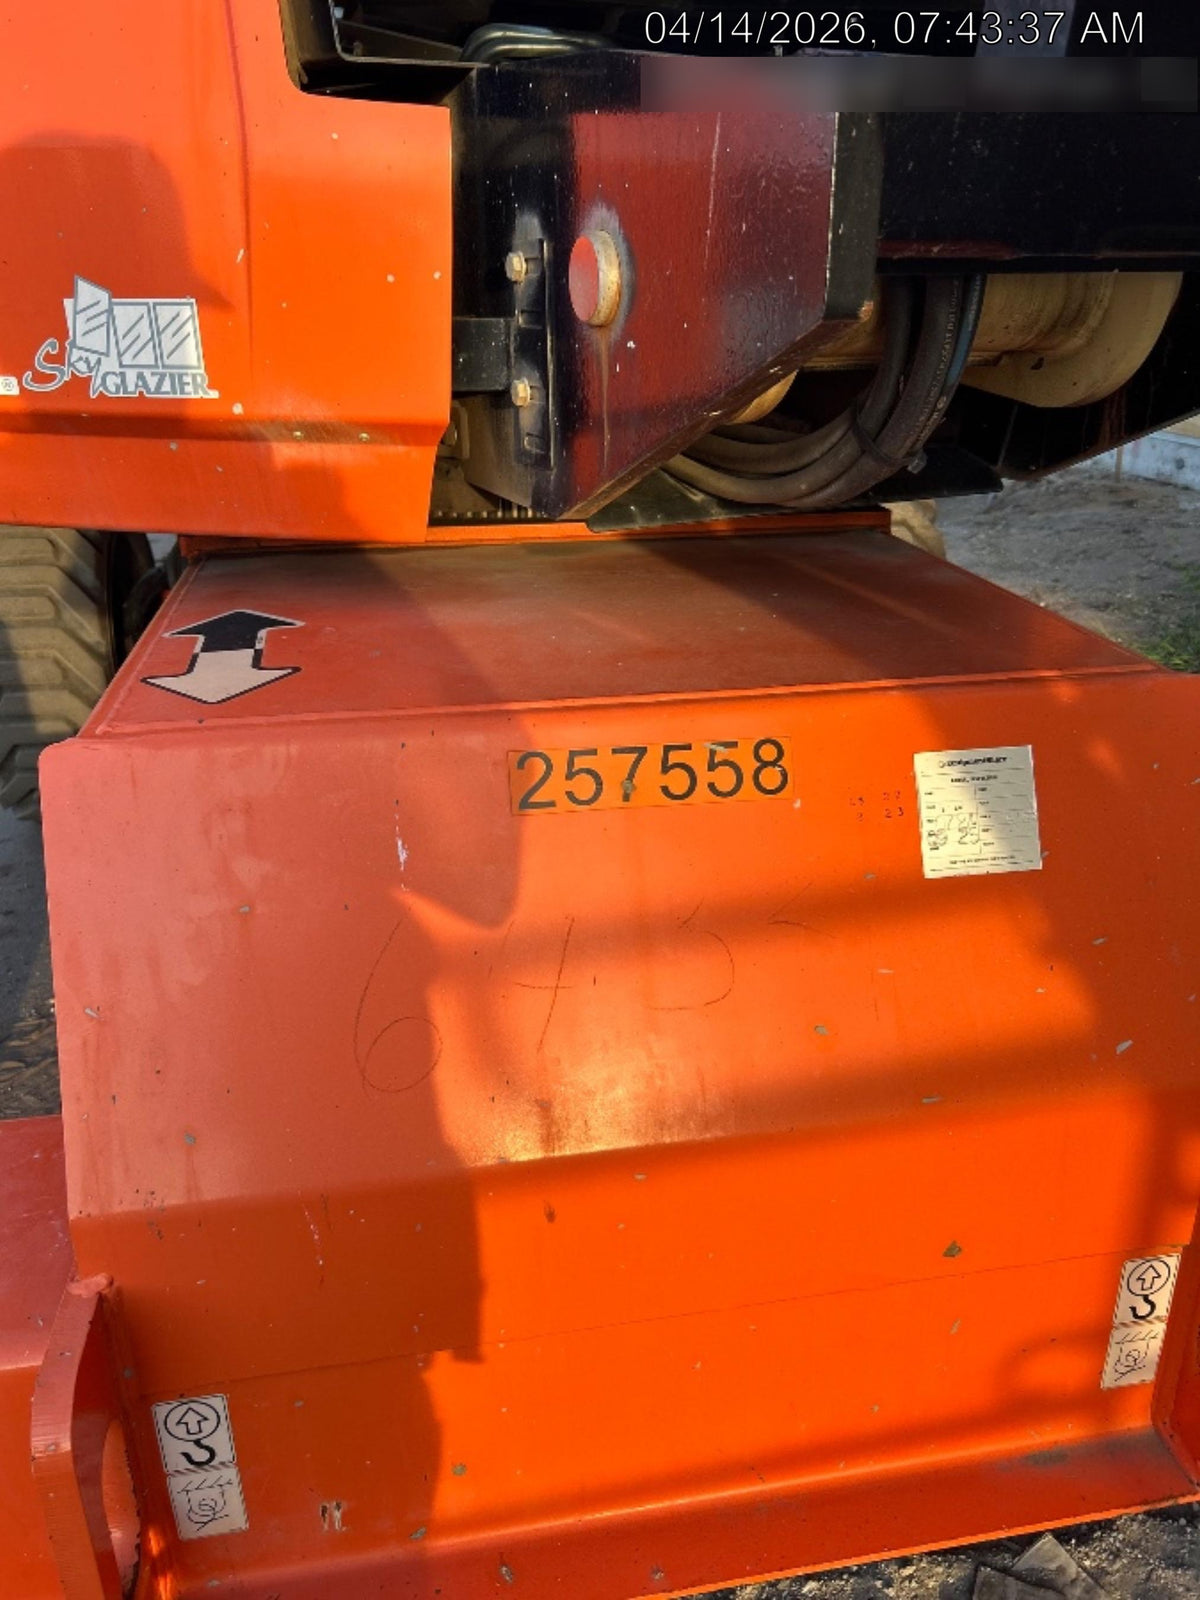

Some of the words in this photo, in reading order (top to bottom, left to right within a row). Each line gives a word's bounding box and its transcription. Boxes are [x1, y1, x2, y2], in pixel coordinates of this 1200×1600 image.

[24, 339, 102, 396] Sky
[101, 371, 210, 396] GLAZIER
[516, 738, 789, 811] 257558
